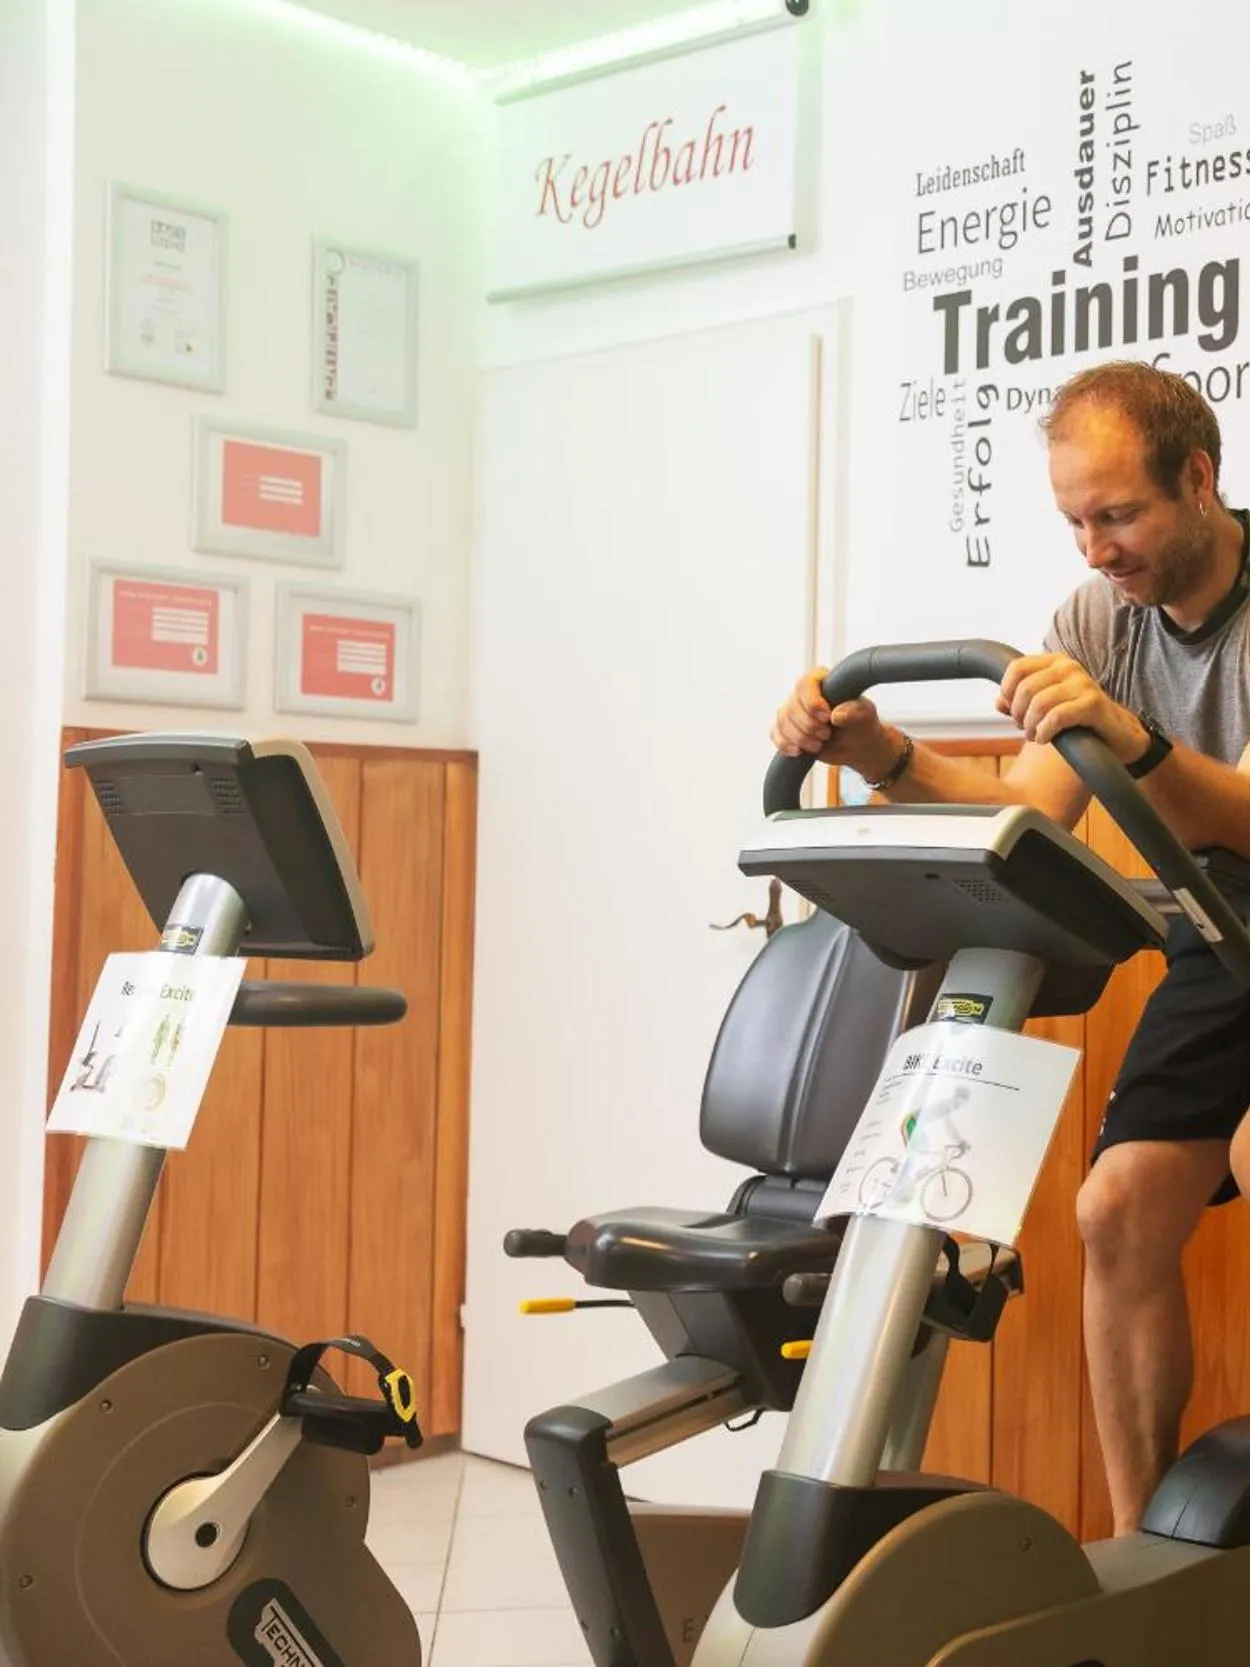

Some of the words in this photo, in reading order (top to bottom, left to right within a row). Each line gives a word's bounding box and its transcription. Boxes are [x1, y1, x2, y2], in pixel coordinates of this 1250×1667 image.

[535, 104, 755, 230] Kegelbahn
[915, 148, 1026, 197] Leidenschaft
[1073, 69, 1096, 268] Ausdauer
[1105, 60, 1140, 240] Disziplin
[1188, 115, 1238, 146] Spaß
[917, 187, 1052, 255] Energie
[903, 256, 1004, 292] Bewegung
[933, 256, 1240, 374] Training
[899, 379, 945, 421] Ziele
[1006, 386, 1059, 415] Dyn
[949, 377, 967, 534] Gesundheit
[966, 383, 1000, 568] Erfolg
